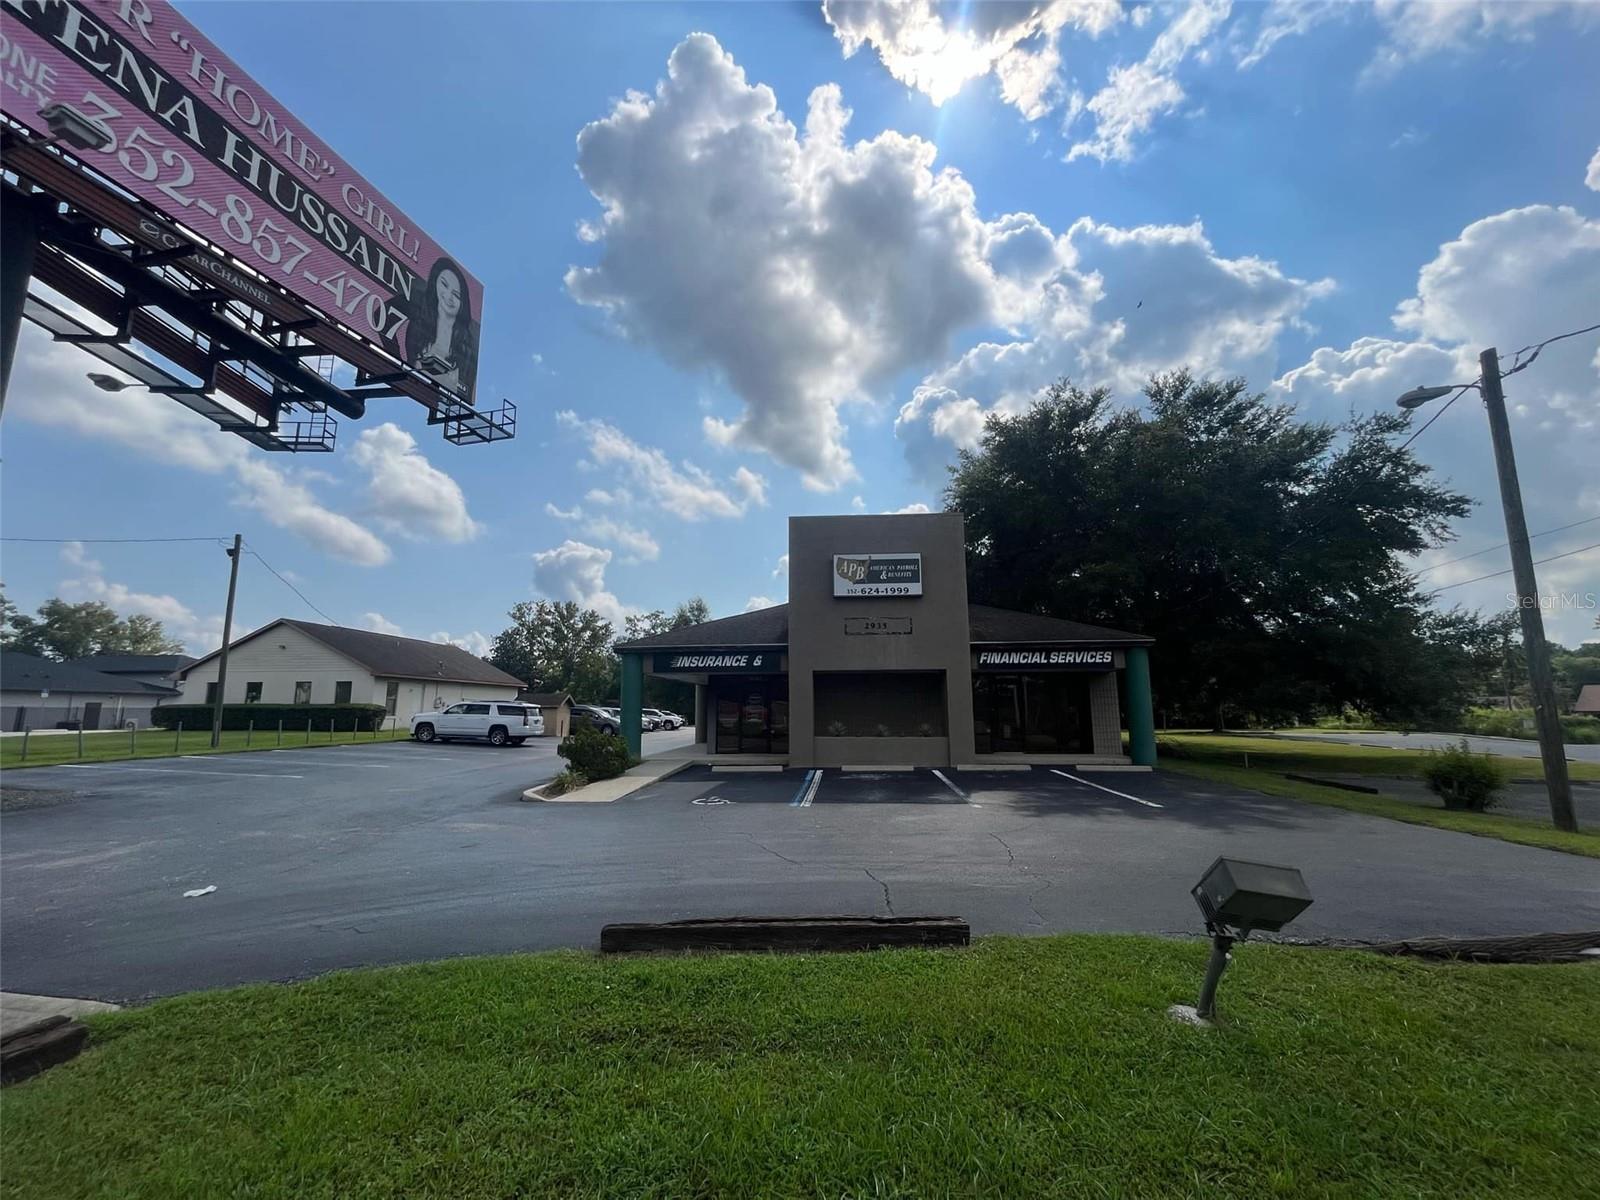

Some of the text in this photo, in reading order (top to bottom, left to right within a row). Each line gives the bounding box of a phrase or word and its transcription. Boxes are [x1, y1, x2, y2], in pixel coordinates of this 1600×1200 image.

[81, 90, 408, 341] 352-857-4707
[217, 125, 416, 301] HUSSAIN
[341, 183, 421, 263] GIRL!
[839, 560, 865, 580] APB
[676, 655, 762, 667] INSURANCE &
[979, 651, 1112, 664] FINANCIAL SERVICES
